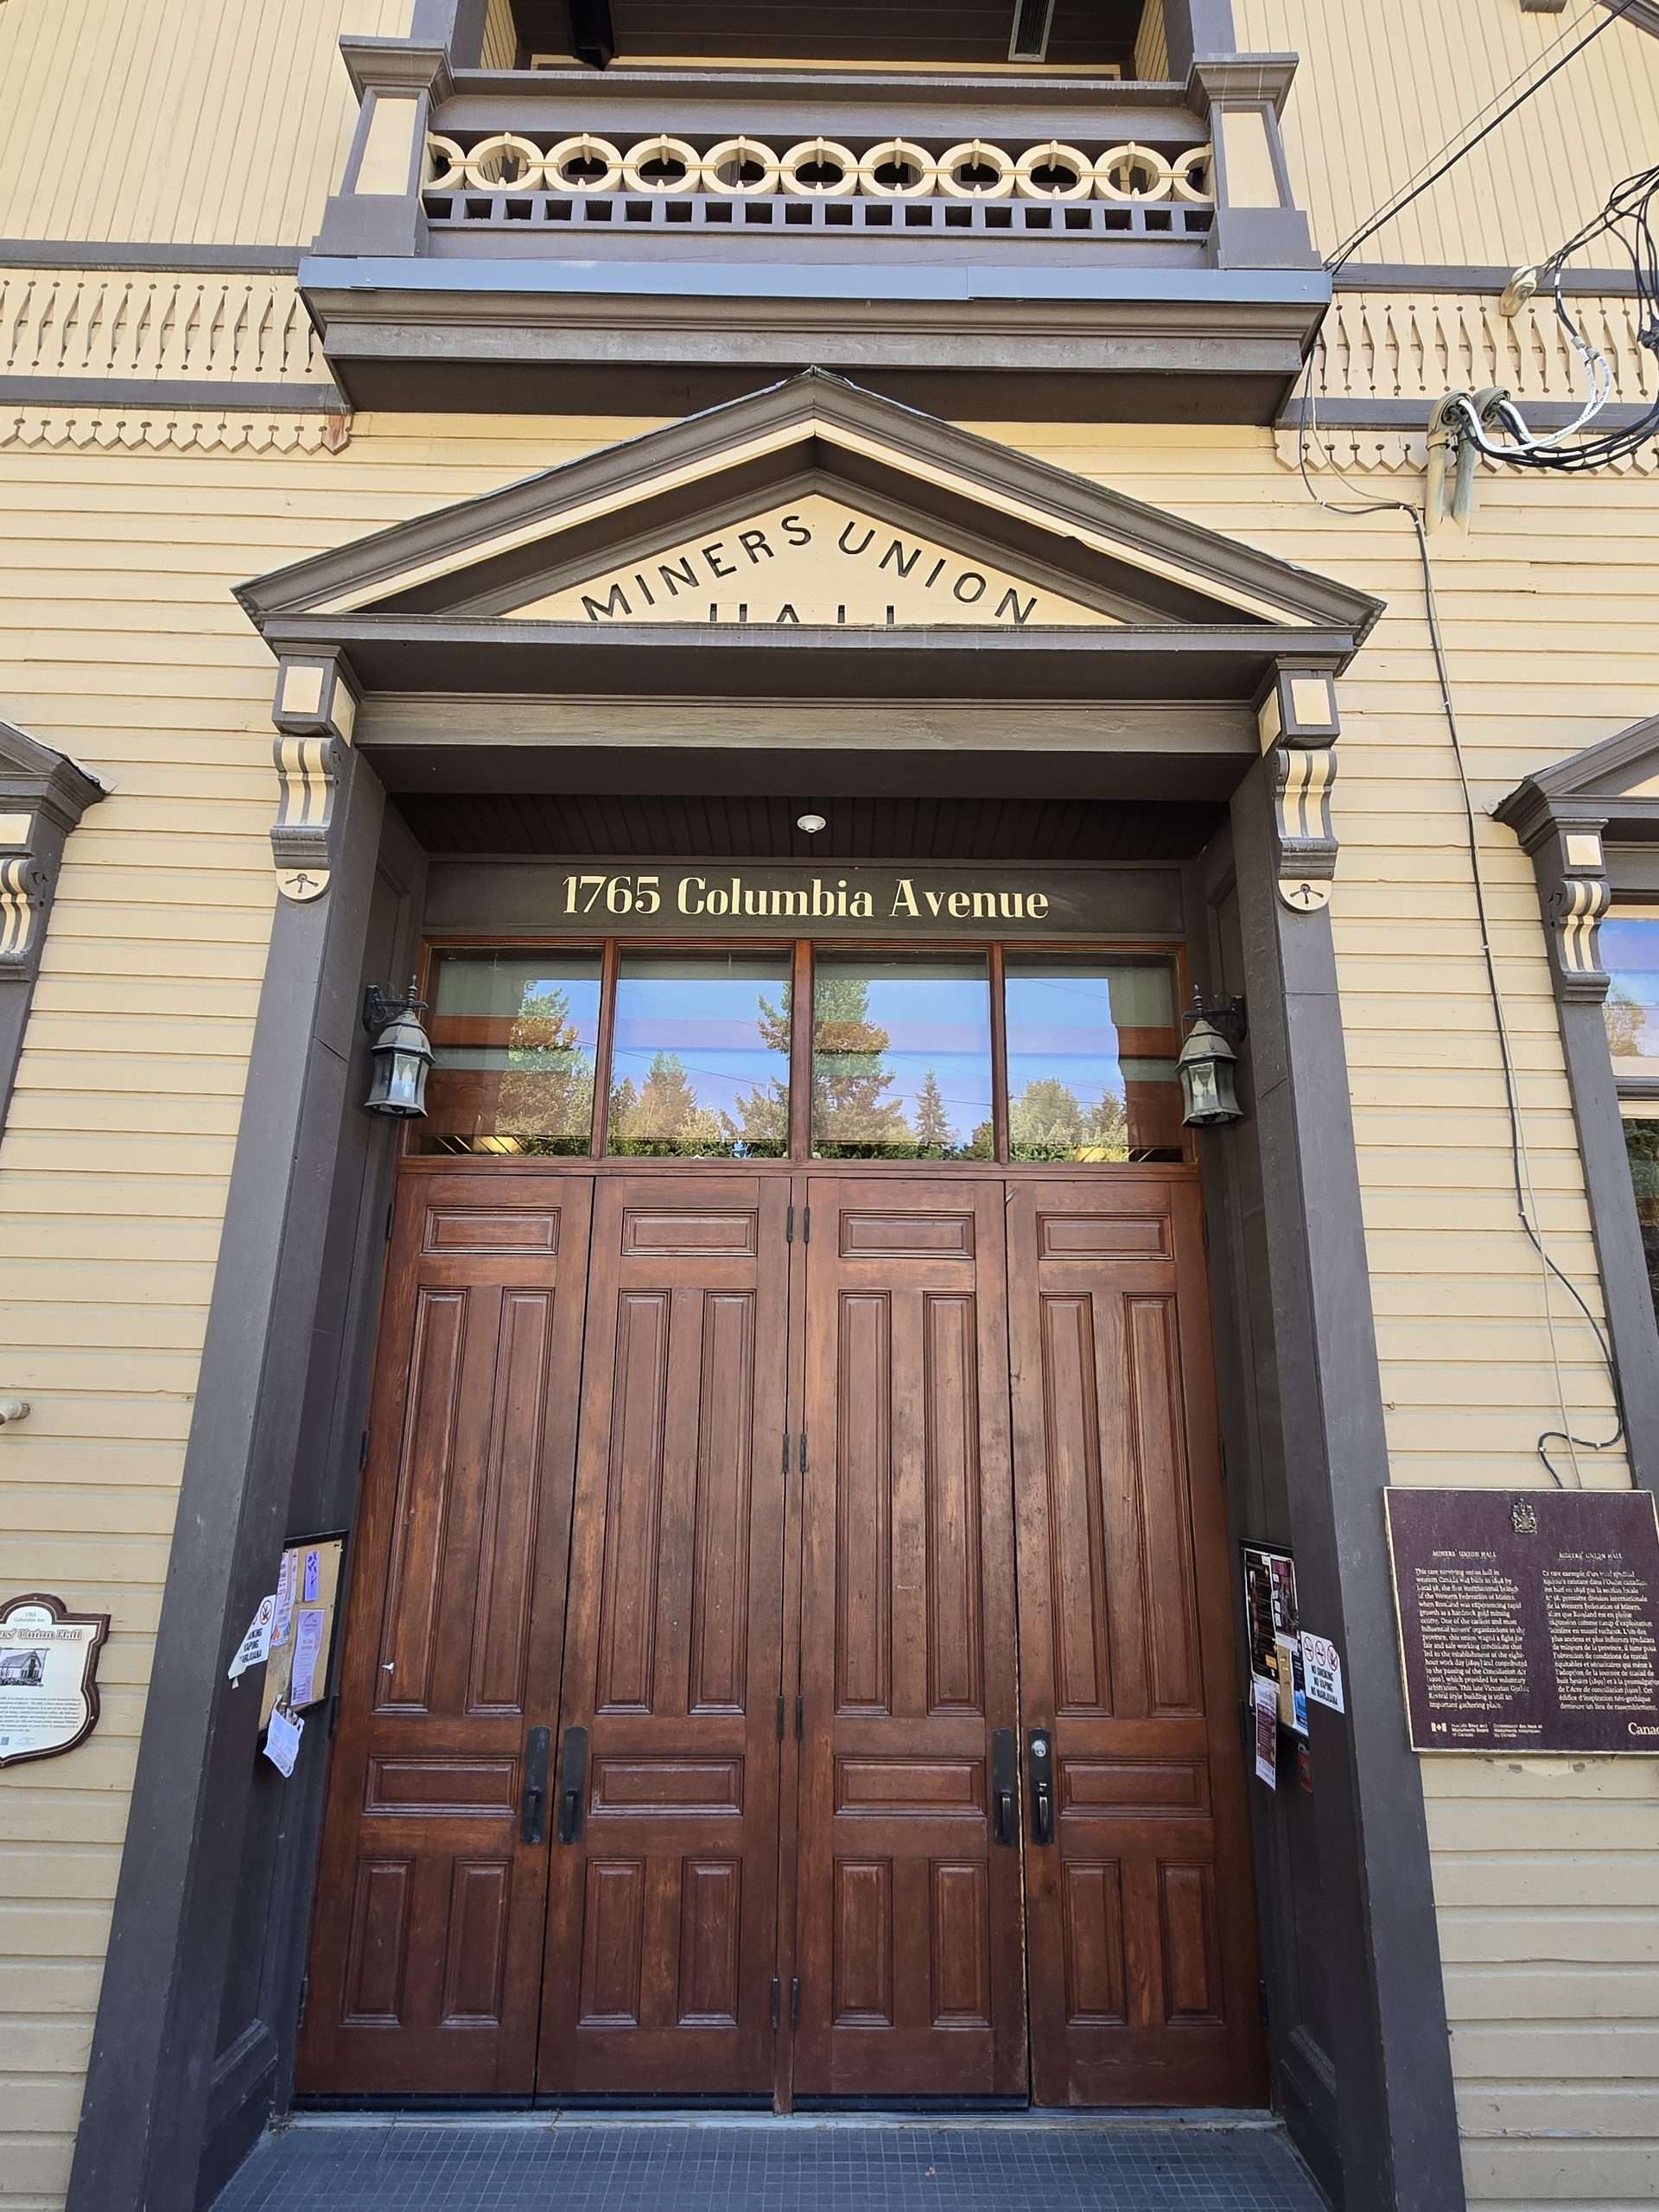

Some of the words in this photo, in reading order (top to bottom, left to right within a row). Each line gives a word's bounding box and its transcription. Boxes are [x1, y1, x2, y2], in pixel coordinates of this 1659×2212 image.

[581, 515, 812, 622] MINERS
[837, 520, 1038, 625] UNION
[563, 875, 661, 914] 1765
[677, 876, 874, 917] Columbia
[888, 878, 1049, 918] Avenue
[18, 1628, 54, 1640] Union
[55, 1629, 82, 1640] Hall
